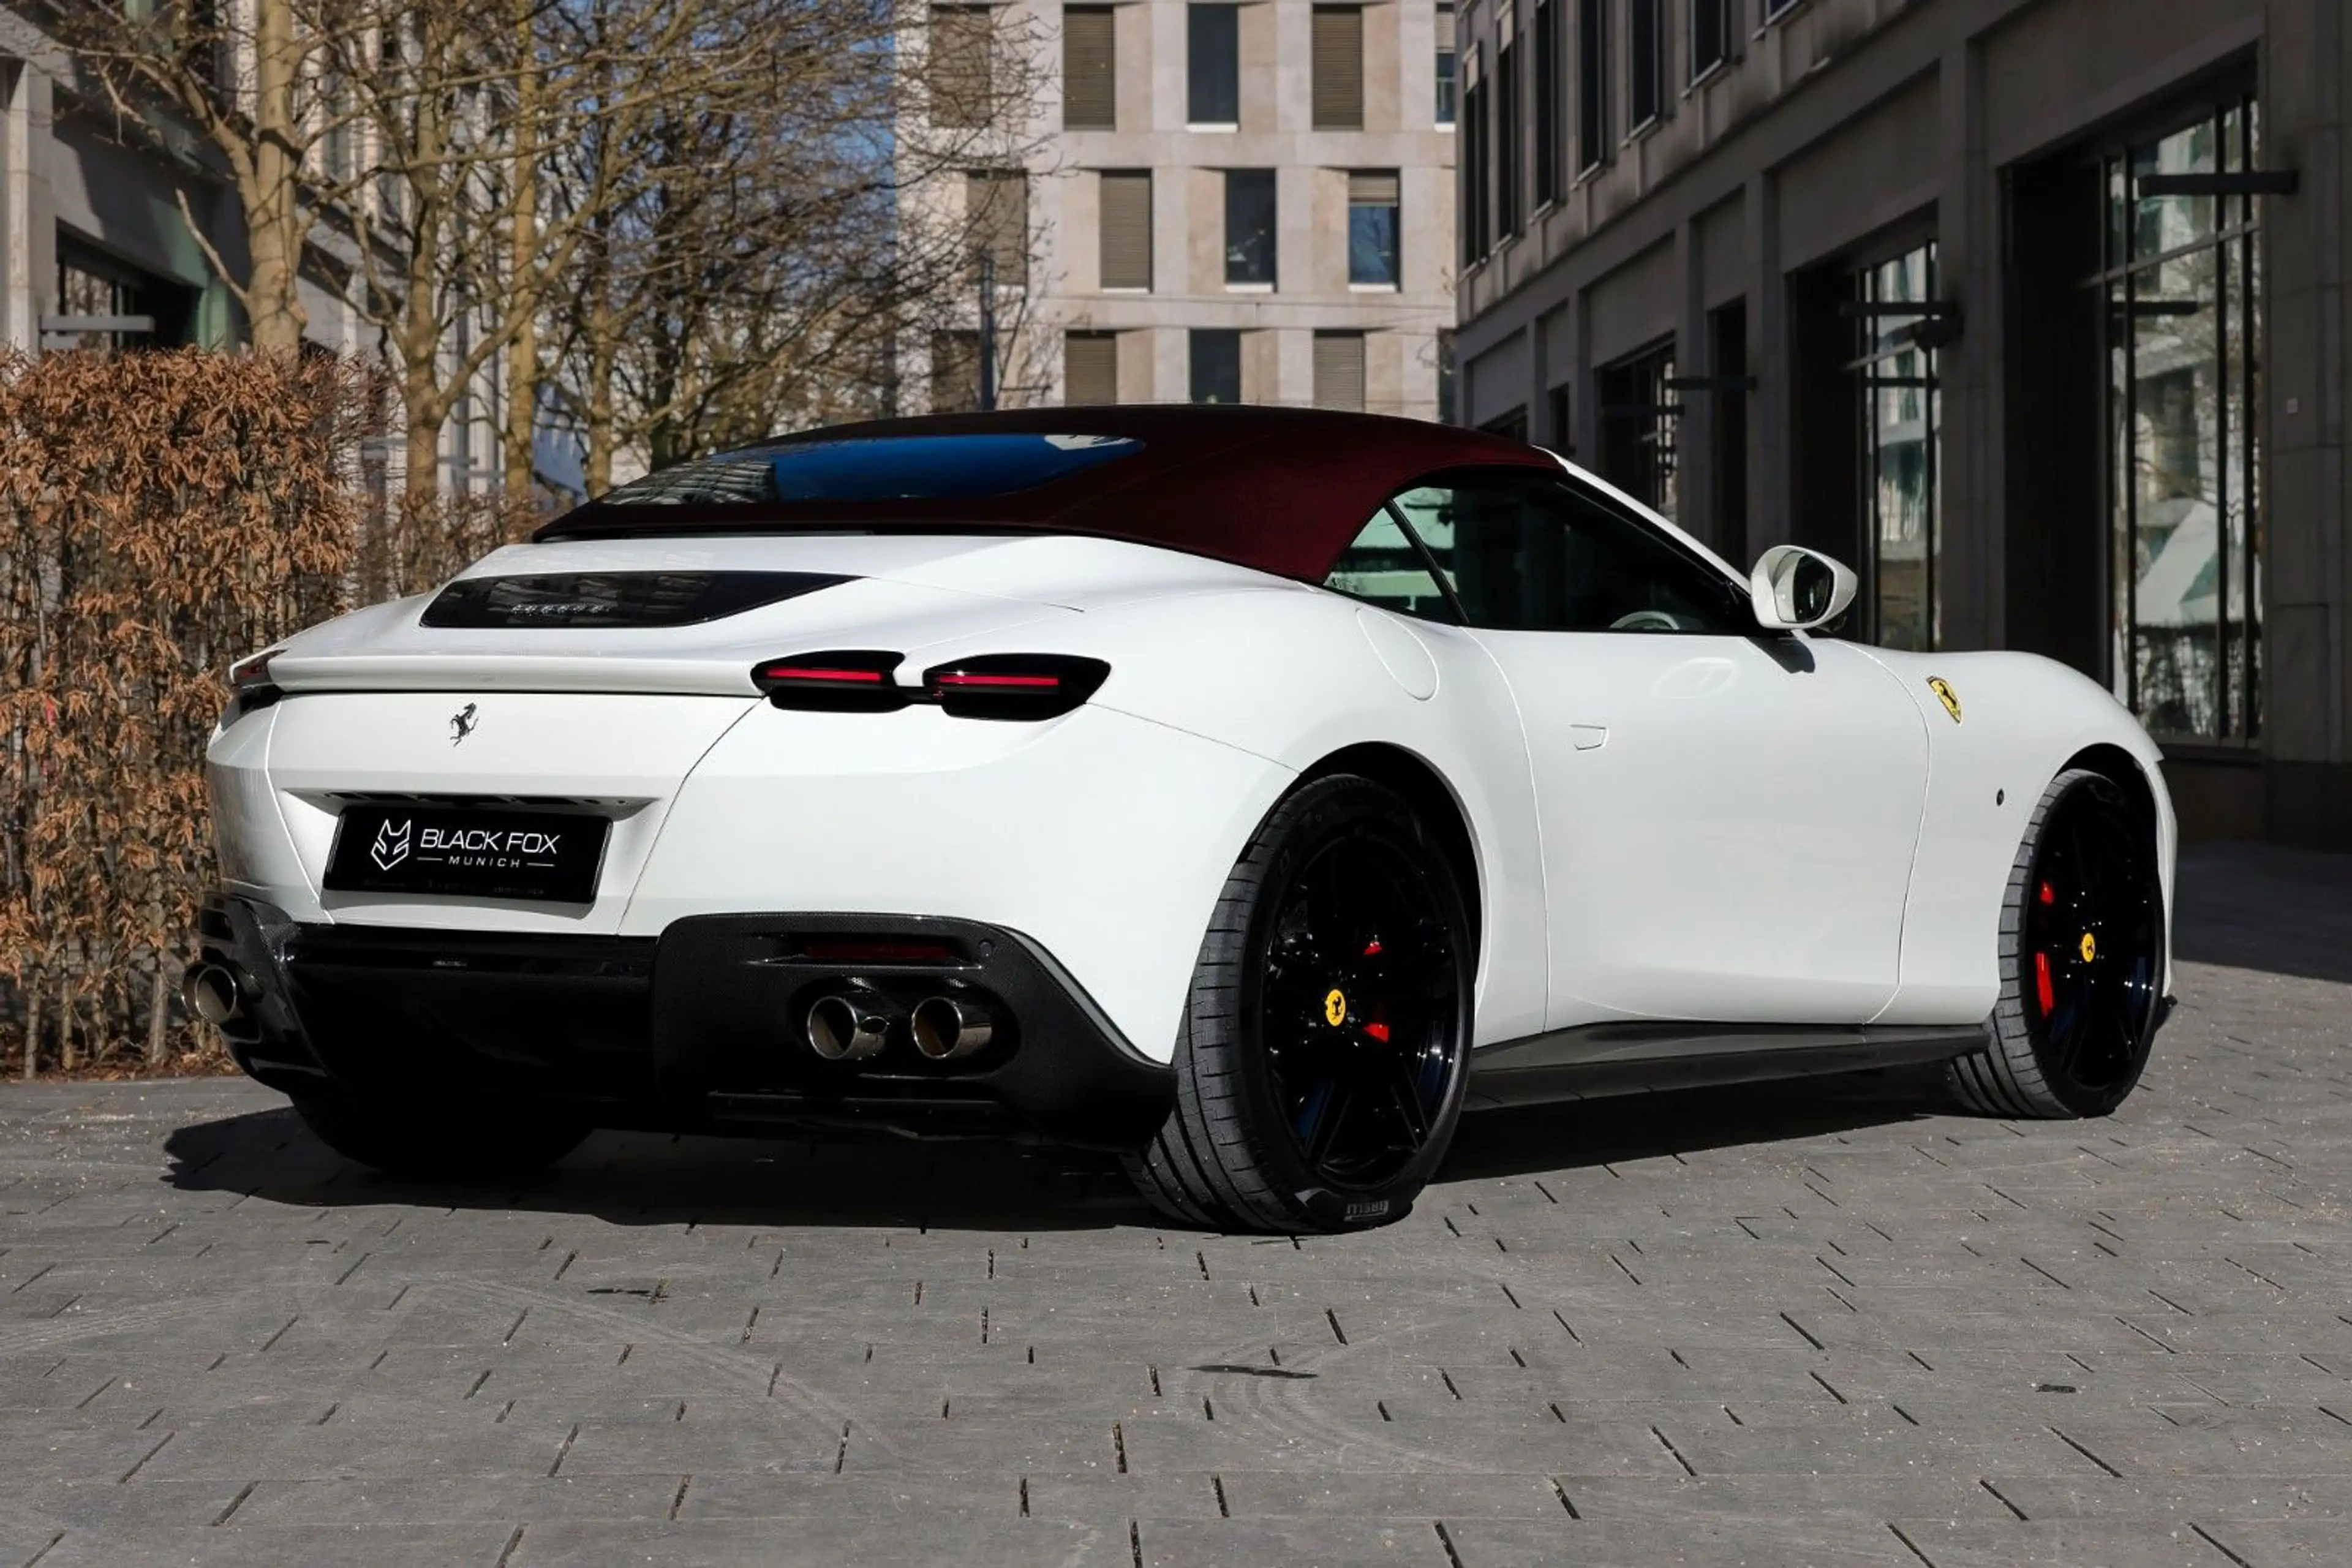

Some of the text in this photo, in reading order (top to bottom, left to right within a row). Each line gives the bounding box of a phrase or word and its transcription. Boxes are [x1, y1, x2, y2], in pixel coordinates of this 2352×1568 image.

[420, 828, 561, 854] BLACK FOX
[448, 855, 521, 868] MUNICH
